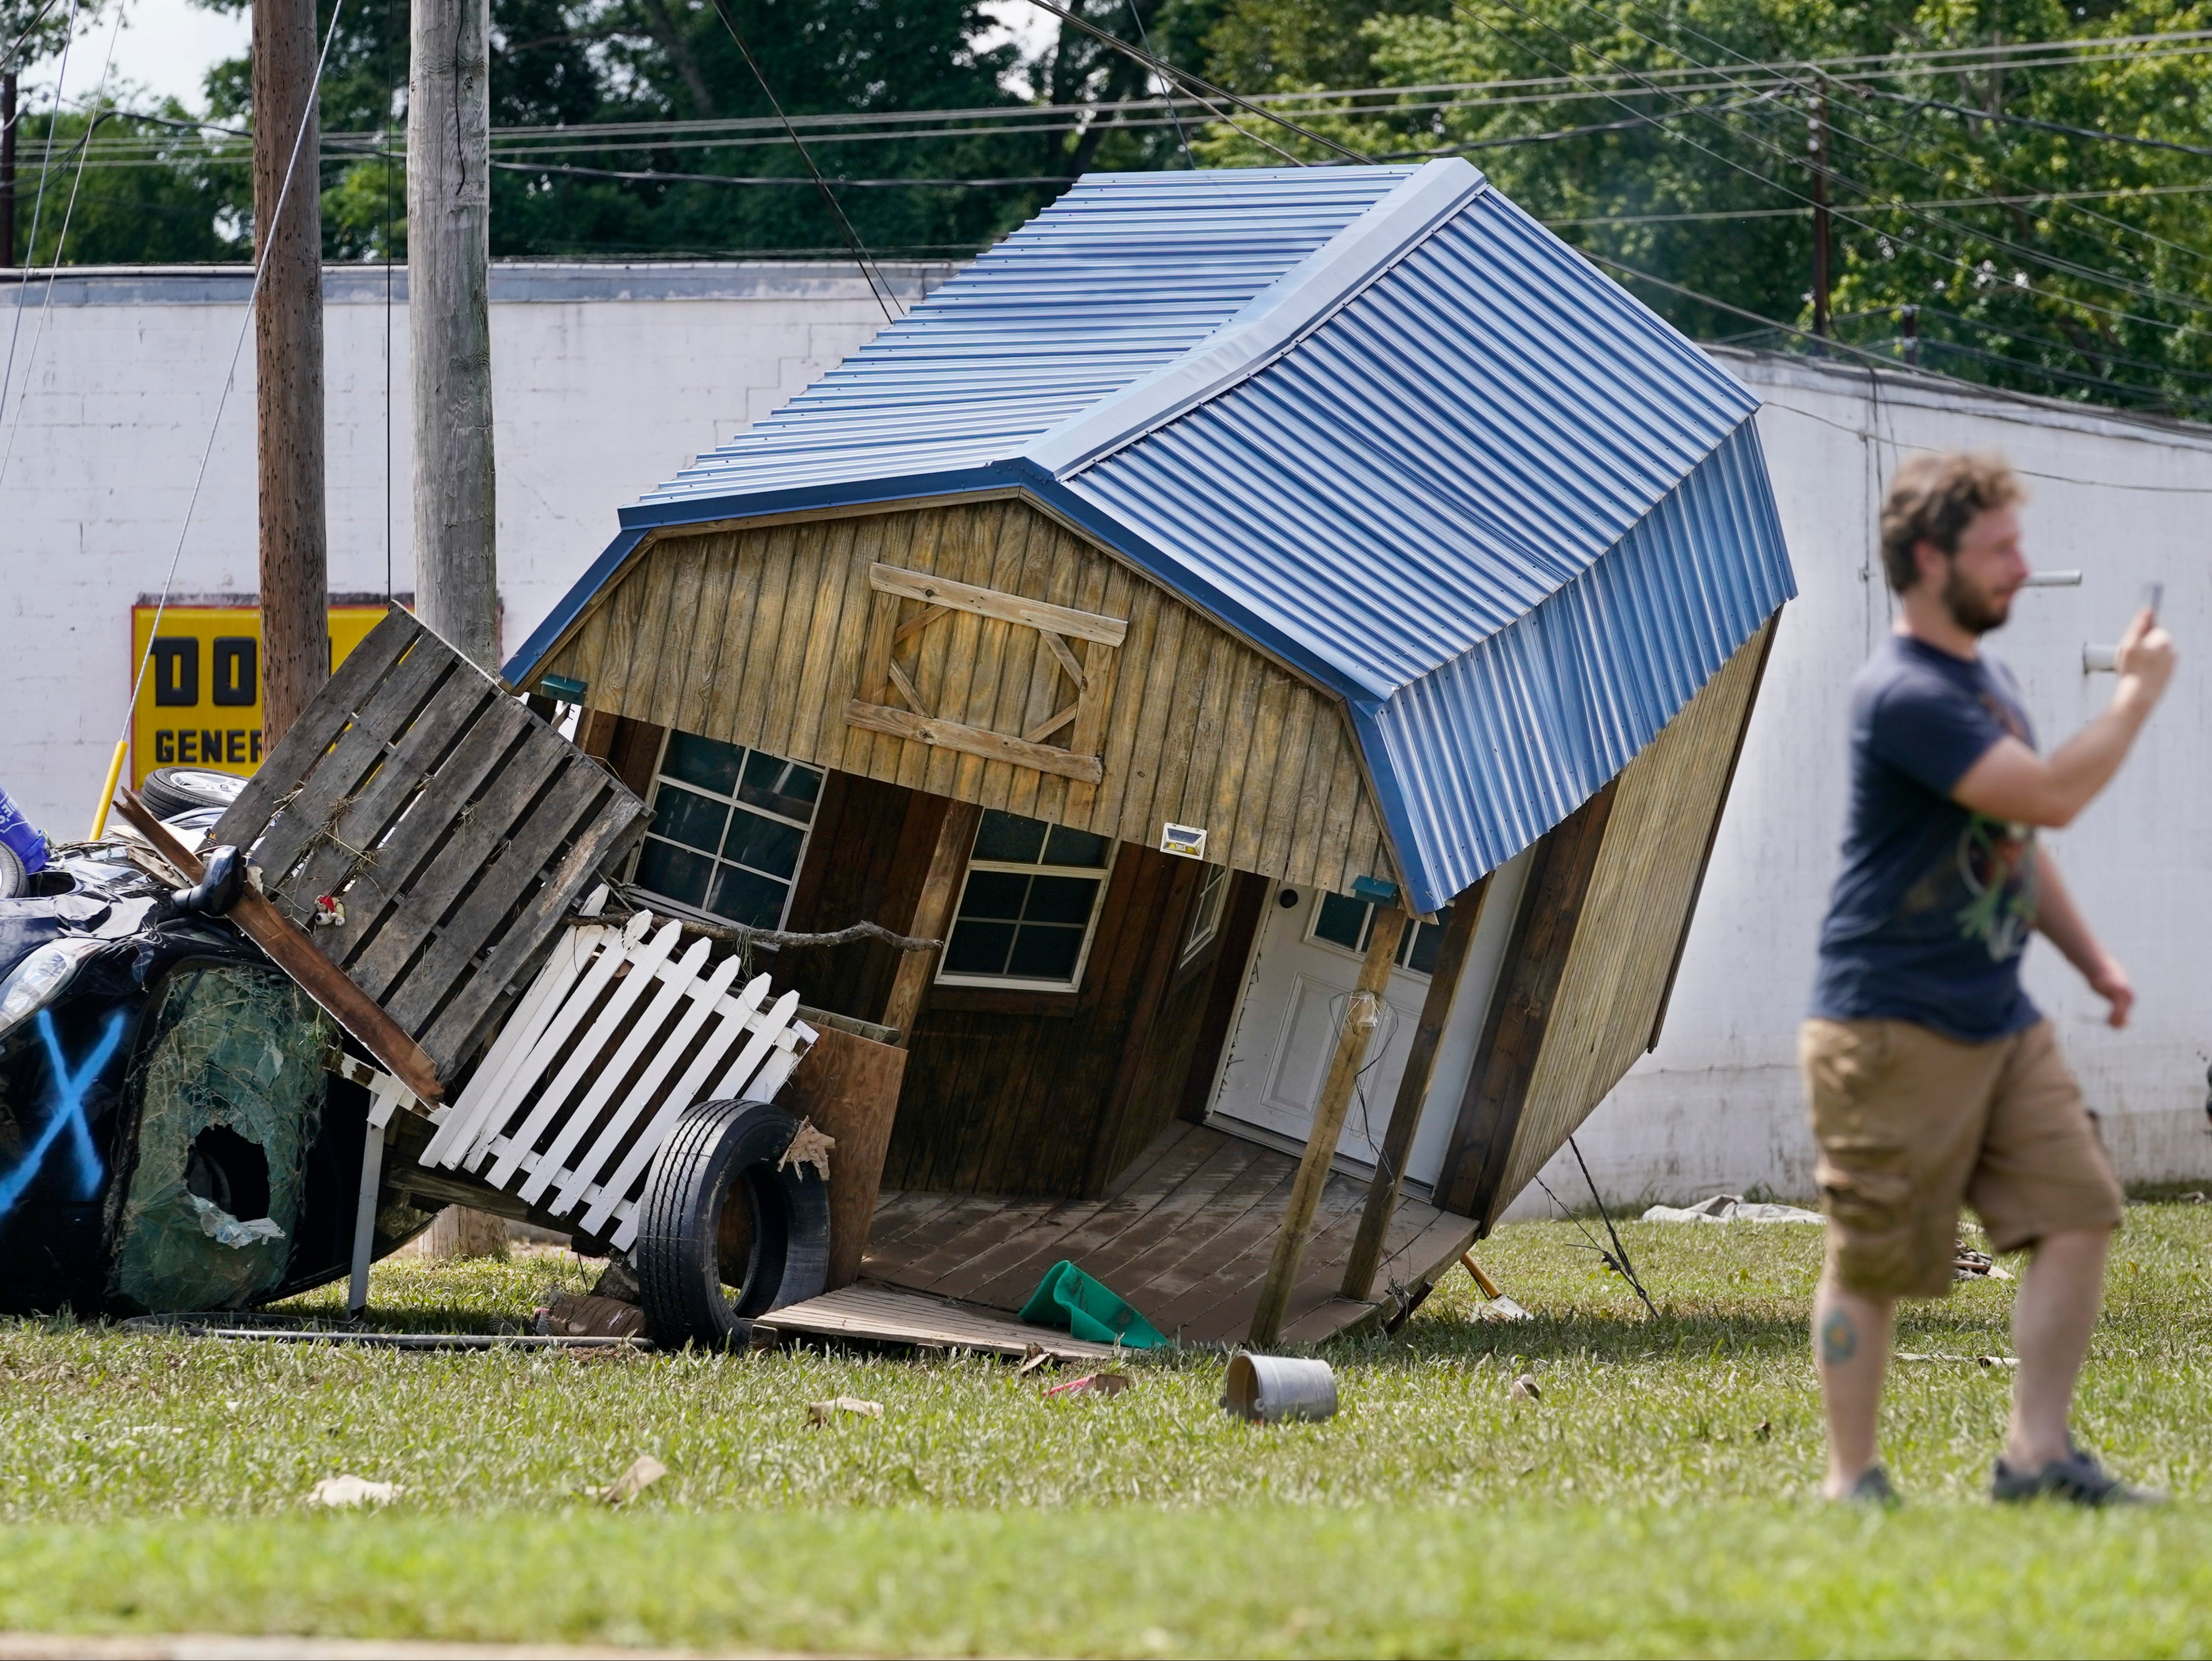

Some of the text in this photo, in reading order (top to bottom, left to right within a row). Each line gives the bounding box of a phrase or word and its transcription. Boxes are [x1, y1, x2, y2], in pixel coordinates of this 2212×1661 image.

[150, 637, 256, 706] DO
[155, 730, 262, 763] GENER
[0, 1009, 124, 1214] X
